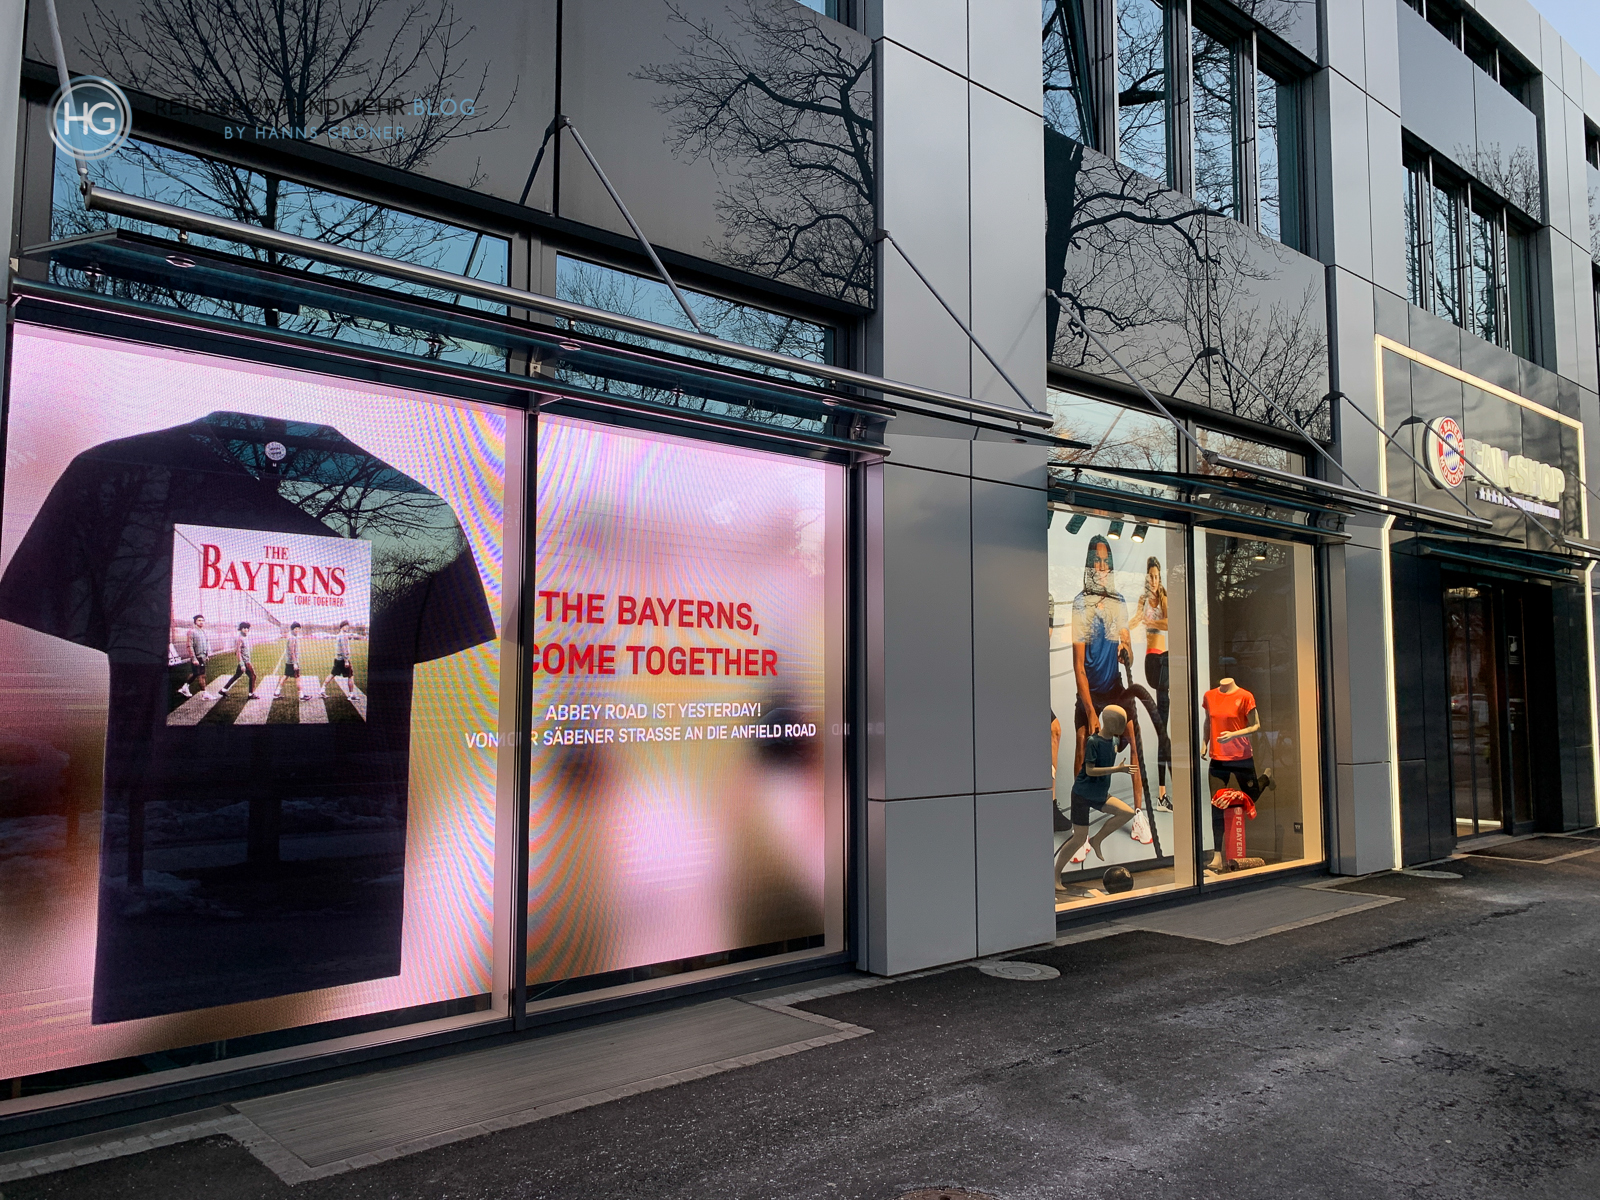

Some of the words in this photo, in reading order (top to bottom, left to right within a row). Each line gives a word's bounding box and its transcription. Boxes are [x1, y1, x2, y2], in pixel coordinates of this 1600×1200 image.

[263, 545, 289, 560] THE
[199, 543, 346, 604] BAYERNS
[294, 595, 311, 606] COME
[539, 590, 605, 624] THE
[617, 595, 759, 636] BAYERNS,
[626, 645, 778, 676] TOGETHER
[545, 705, 601, 721] ABBEY
[605, 704, 648, 719] ROAD
[652, 703, 676, 719] IST
[678, 702, 761, 718] YESTERDAY!
[543, 727, 614, 746] SÄBENER
[618, 727, 681, 743] STRASSE
[684, 725, 703, 740] AN
[707, 725, 727, 740] DIE
[731, 724, 782, 739] ANFIELD
[785, 723, 817, 738] ROAD
[1236, 816, 1242, 826] FC
